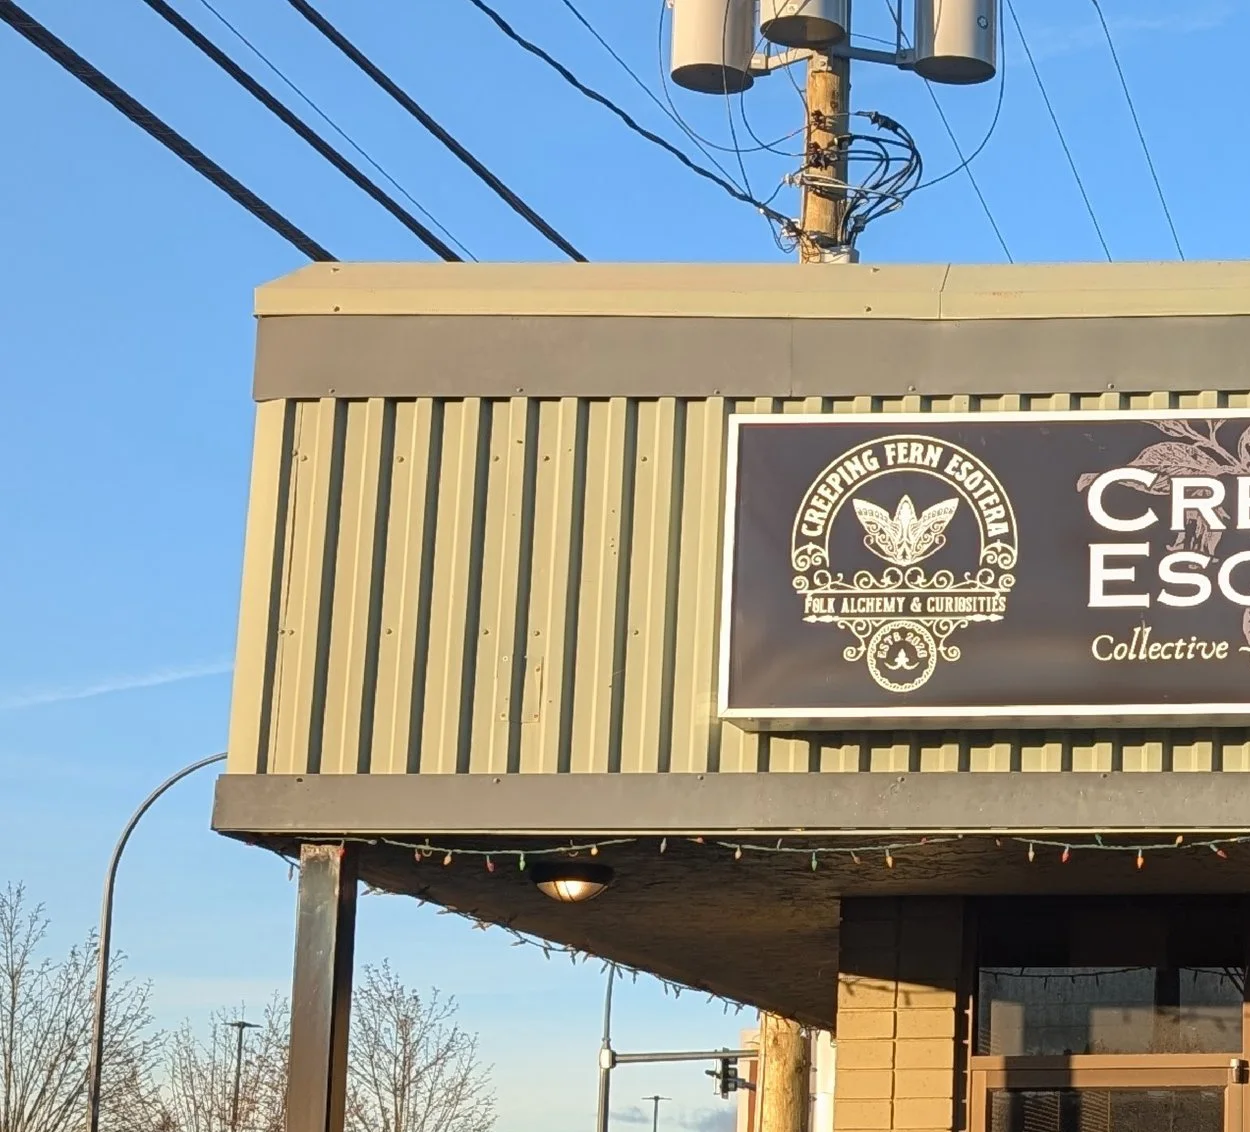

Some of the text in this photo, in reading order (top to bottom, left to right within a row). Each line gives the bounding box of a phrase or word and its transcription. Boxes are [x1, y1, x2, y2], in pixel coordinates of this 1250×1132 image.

[801, 442, 1009, 537] CREEPING FERN ESOTERA
[804, 597, 1007, 613] FOLK ALCHEMY & CURIOSITIES
[1091, 626, 1228, 661] Collective
